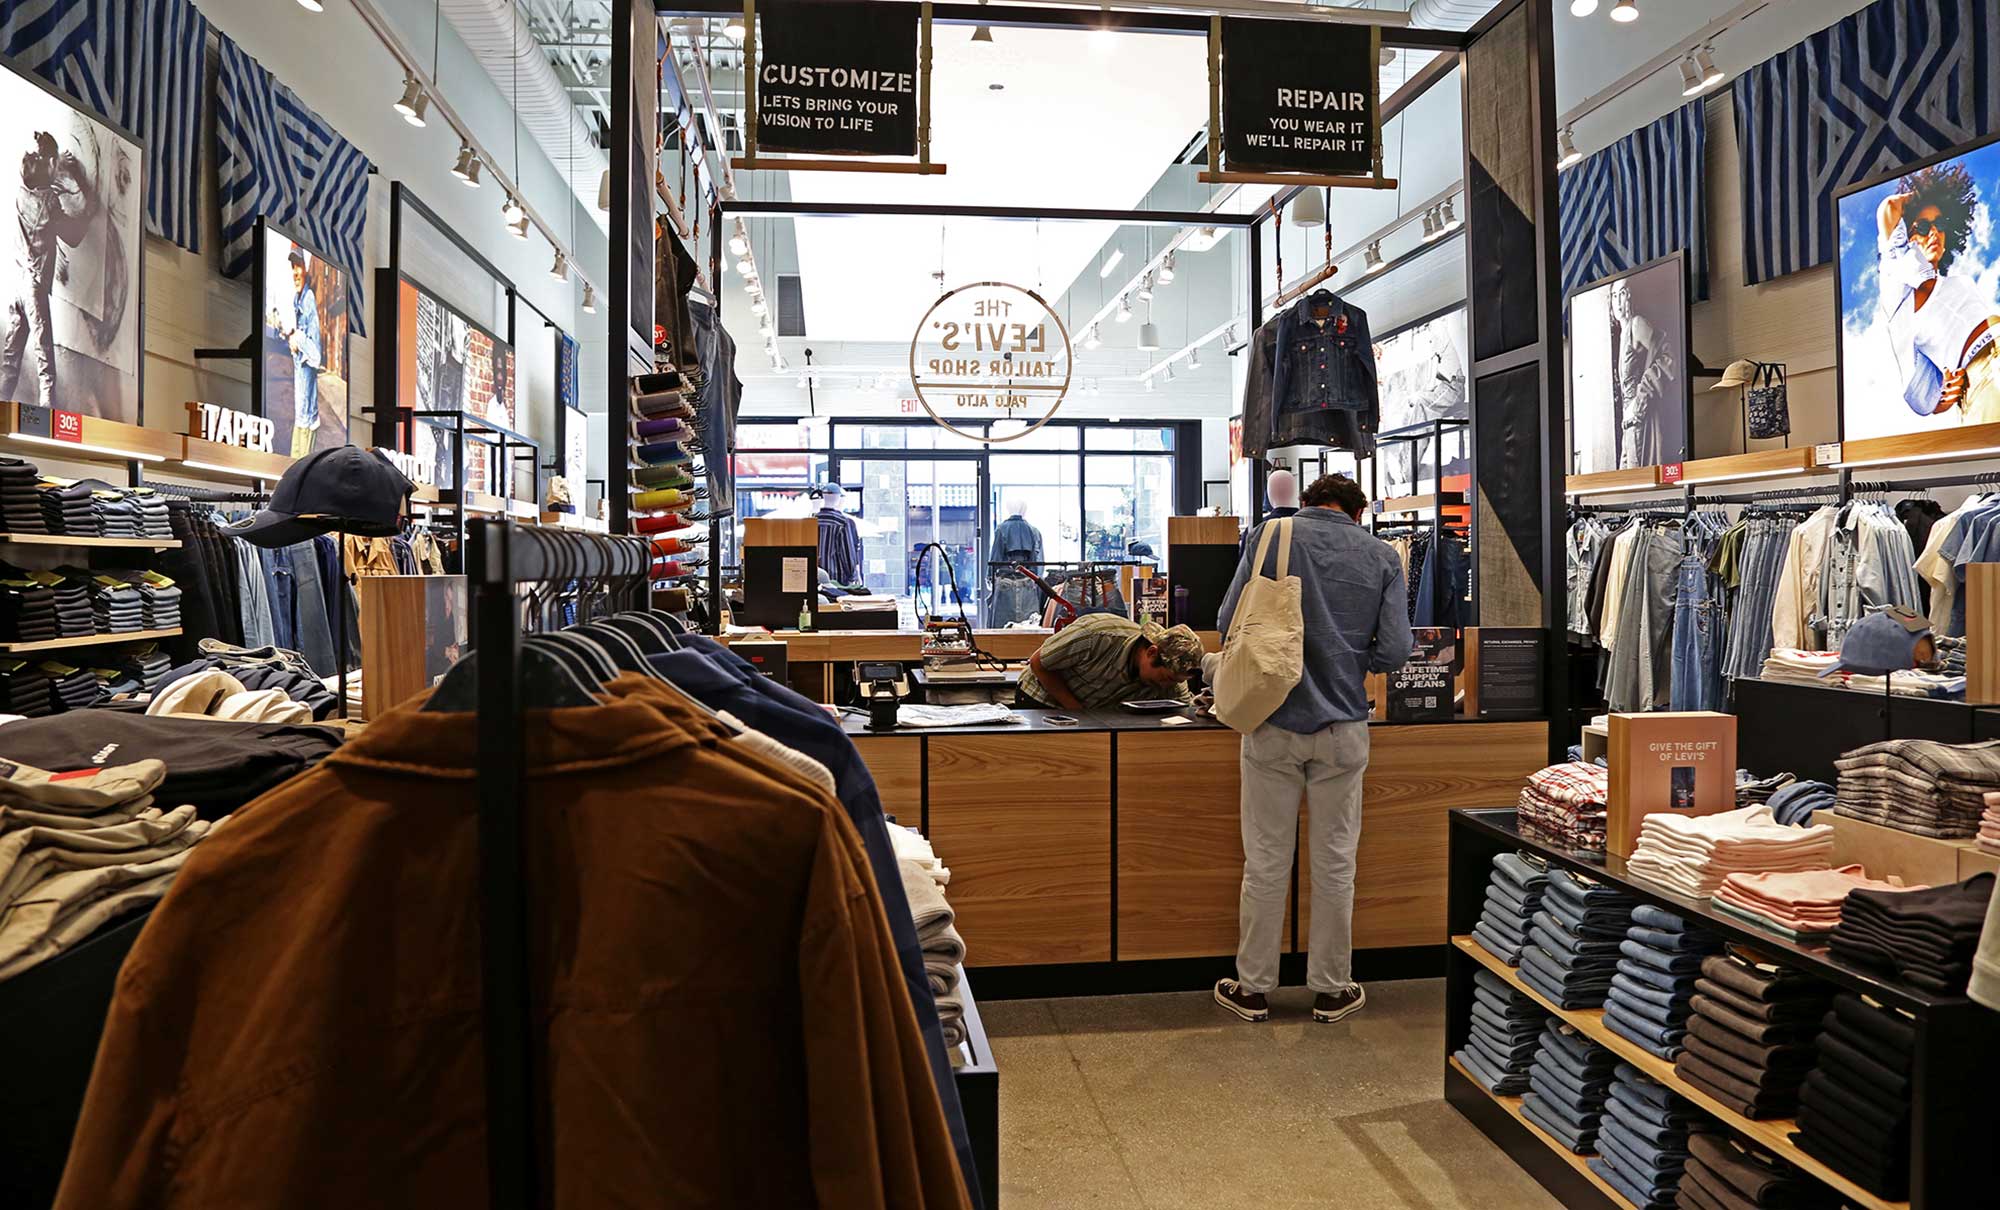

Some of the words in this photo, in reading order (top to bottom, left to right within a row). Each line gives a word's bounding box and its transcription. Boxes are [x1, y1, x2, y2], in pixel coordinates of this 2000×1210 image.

[763, 64, 912, 93] CUSTOMIZE
[763, 95, 801, 109] LETS
[806, 98, 852, 111] BRING
[857, 100, 898, 116] YOUR
[1277, 88, 1365, 111] REPAIR
[763, 113, 811, 129] VISION
[815, 117, 835, 130] TO
[840, 117, 873, 132] LIFE
[1269, 117, 1299, 131] YOU
[1304, 120, 1345, 134] WEAR
[1351, 122, 1365, 134] IT
[1246, 134, 1289, 148] WE'LL
[1294, 136, 1346, 151] REPAIR
[1351, 140, 1365, 152] IT
[901, 399, 918, 413] EXIT
[59, 413, 79, 430] 30%
[203, 402, 275, 454] TAPER
[1401, 673, 1440, 681] SUPPLY
[1402, 666, 1449, 674] LIFETIME
[1412, 680, 1446, 688] JEANS
[1649, 743, 1673, 752] GIVE
[1674, 742, 1694, 751] THE
[1696, 741, 1718, 750] GIFT
[1659, 752, 1673, 761] OF
[1675, 752, 1705, 760] LEVI'S
